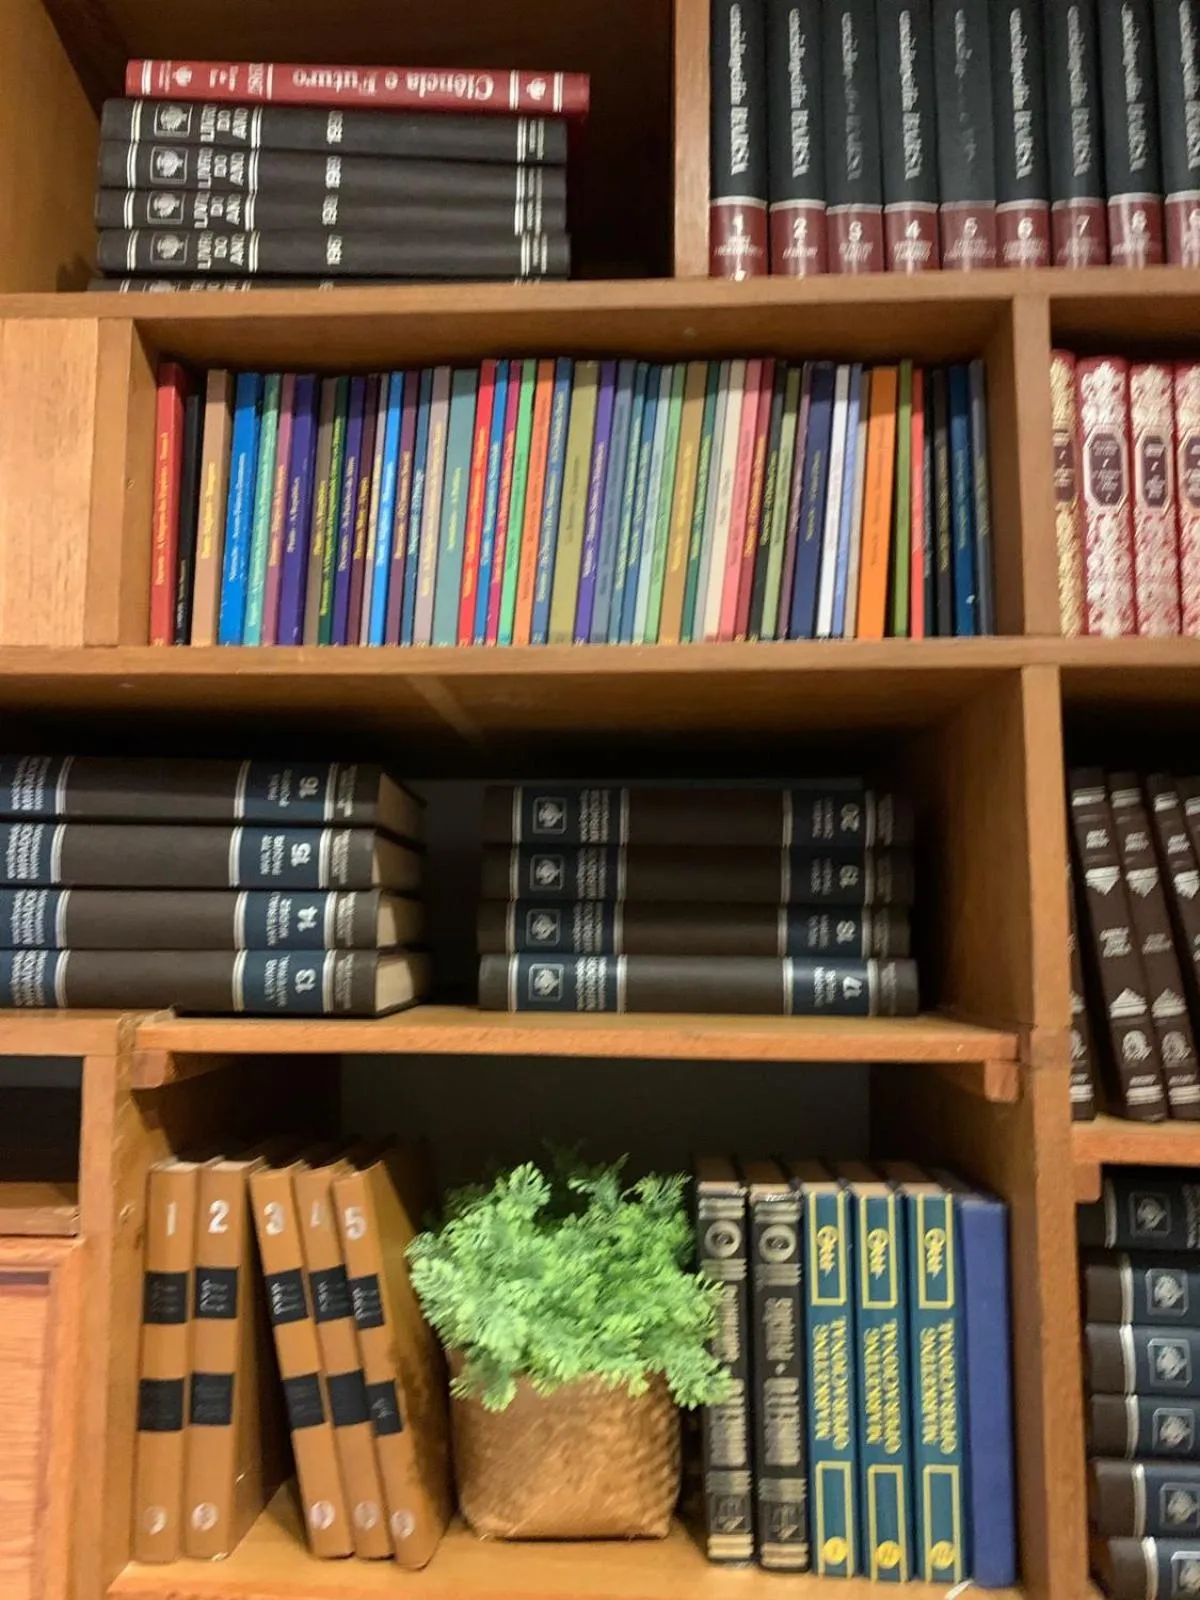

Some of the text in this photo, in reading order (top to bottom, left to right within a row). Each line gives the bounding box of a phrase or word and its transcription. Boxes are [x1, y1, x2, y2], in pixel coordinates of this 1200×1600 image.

[292, 69, 377, 97] Futuro
[385, 70, 398, 91] e
[216, 110, 231, 131] DO
[730, 107, 750, 176] BARSA
[790, 109, 809, 178] BARSA
[902, 112, 922, 181] BARSA
[1014, 110, 1034, 180] BARSA
[1071, 107, 1092, 177] BARSA
[213, 155, 227, 178] DO
[209, 196, 224, 217] DO
[733, 214, 744, 236] 1
[793, 216, 807, 239] 2
[849, 221, 863, 241] 3
[905, 219, 922, 240] 4
[1017, 217, 1033, 239] 6
[1076, 214, 1090, 237] 7
[213, 236, 227, 258] DO
[300, 776, 320, 798] 16
[840, 803, 860, 833] 20
[291, 842, 311, 868] 15
[298, 905, 318, 932] 14
[295, 968, 316, 994] 13
[842, 976, 863, 1000] 17
[165, 1202, 176, 1236] 1
[207, 1200, 231, 1233] 2
[263, 1203, 285, 1236] 3
[343, 1206, 367, 1240] 5
